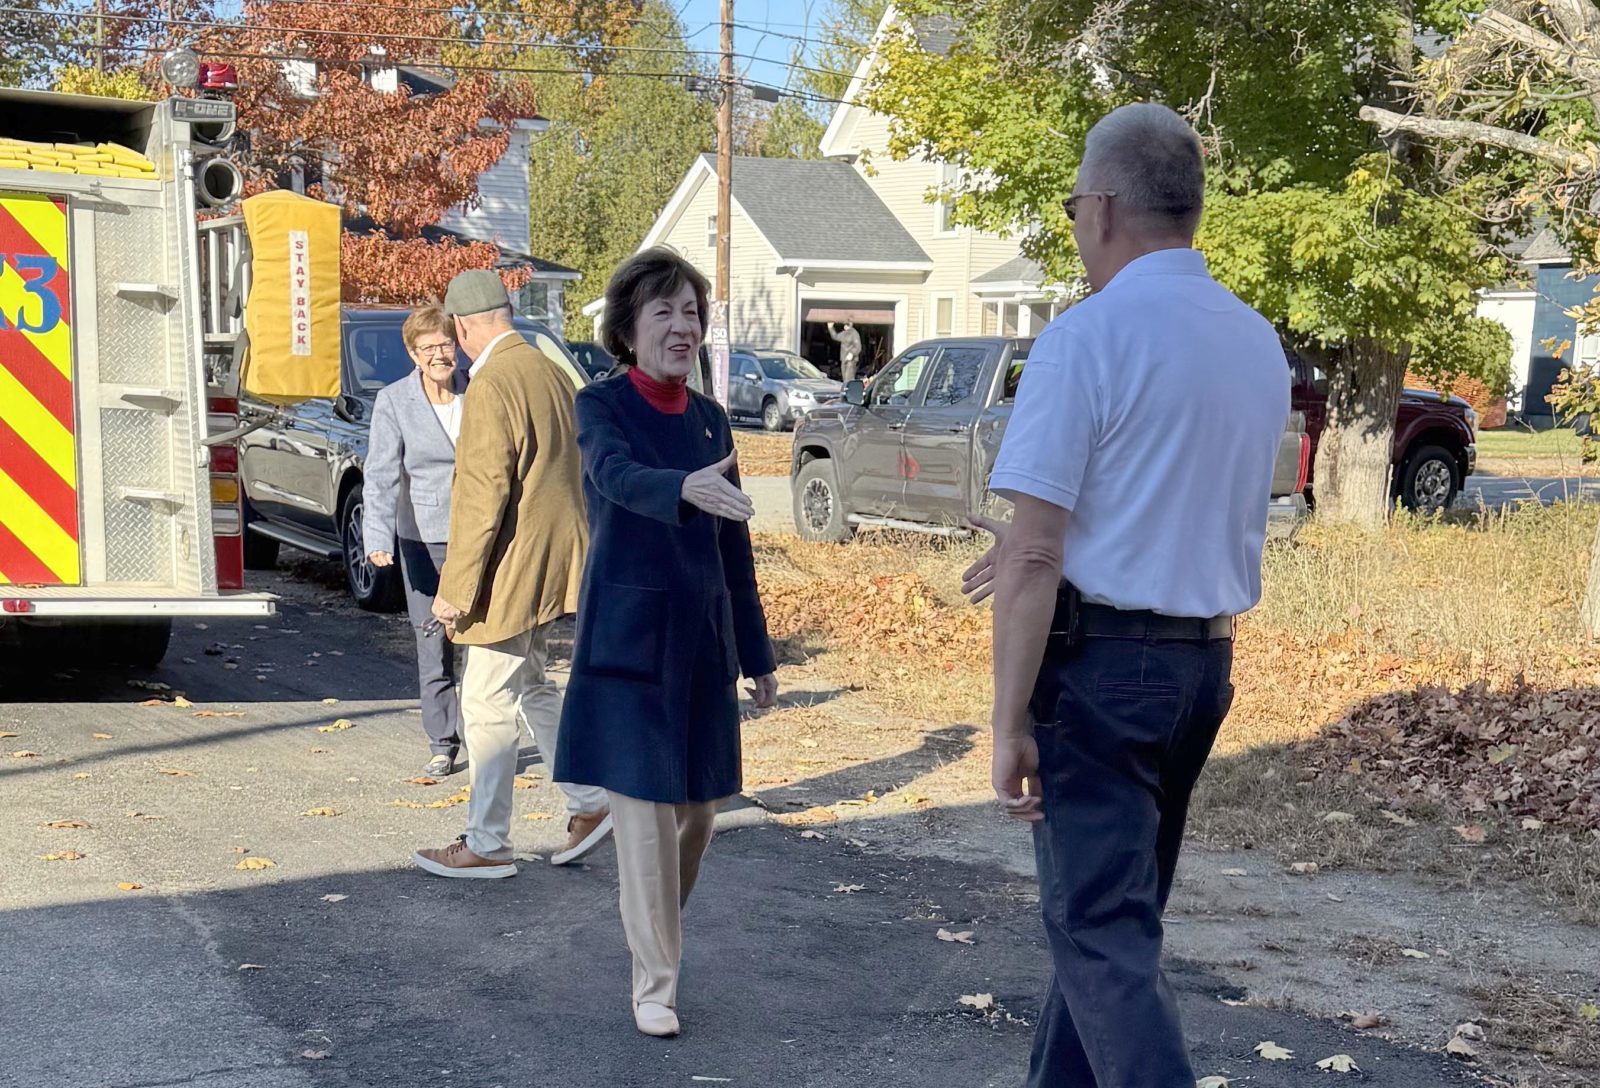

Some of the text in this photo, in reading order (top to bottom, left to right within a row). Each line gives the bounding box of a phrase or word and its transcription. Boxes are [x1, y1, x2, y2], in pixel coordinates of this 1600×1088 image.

[0, 253, 63, 333] 3
[295, 241, 306, 344] STAY BACK
